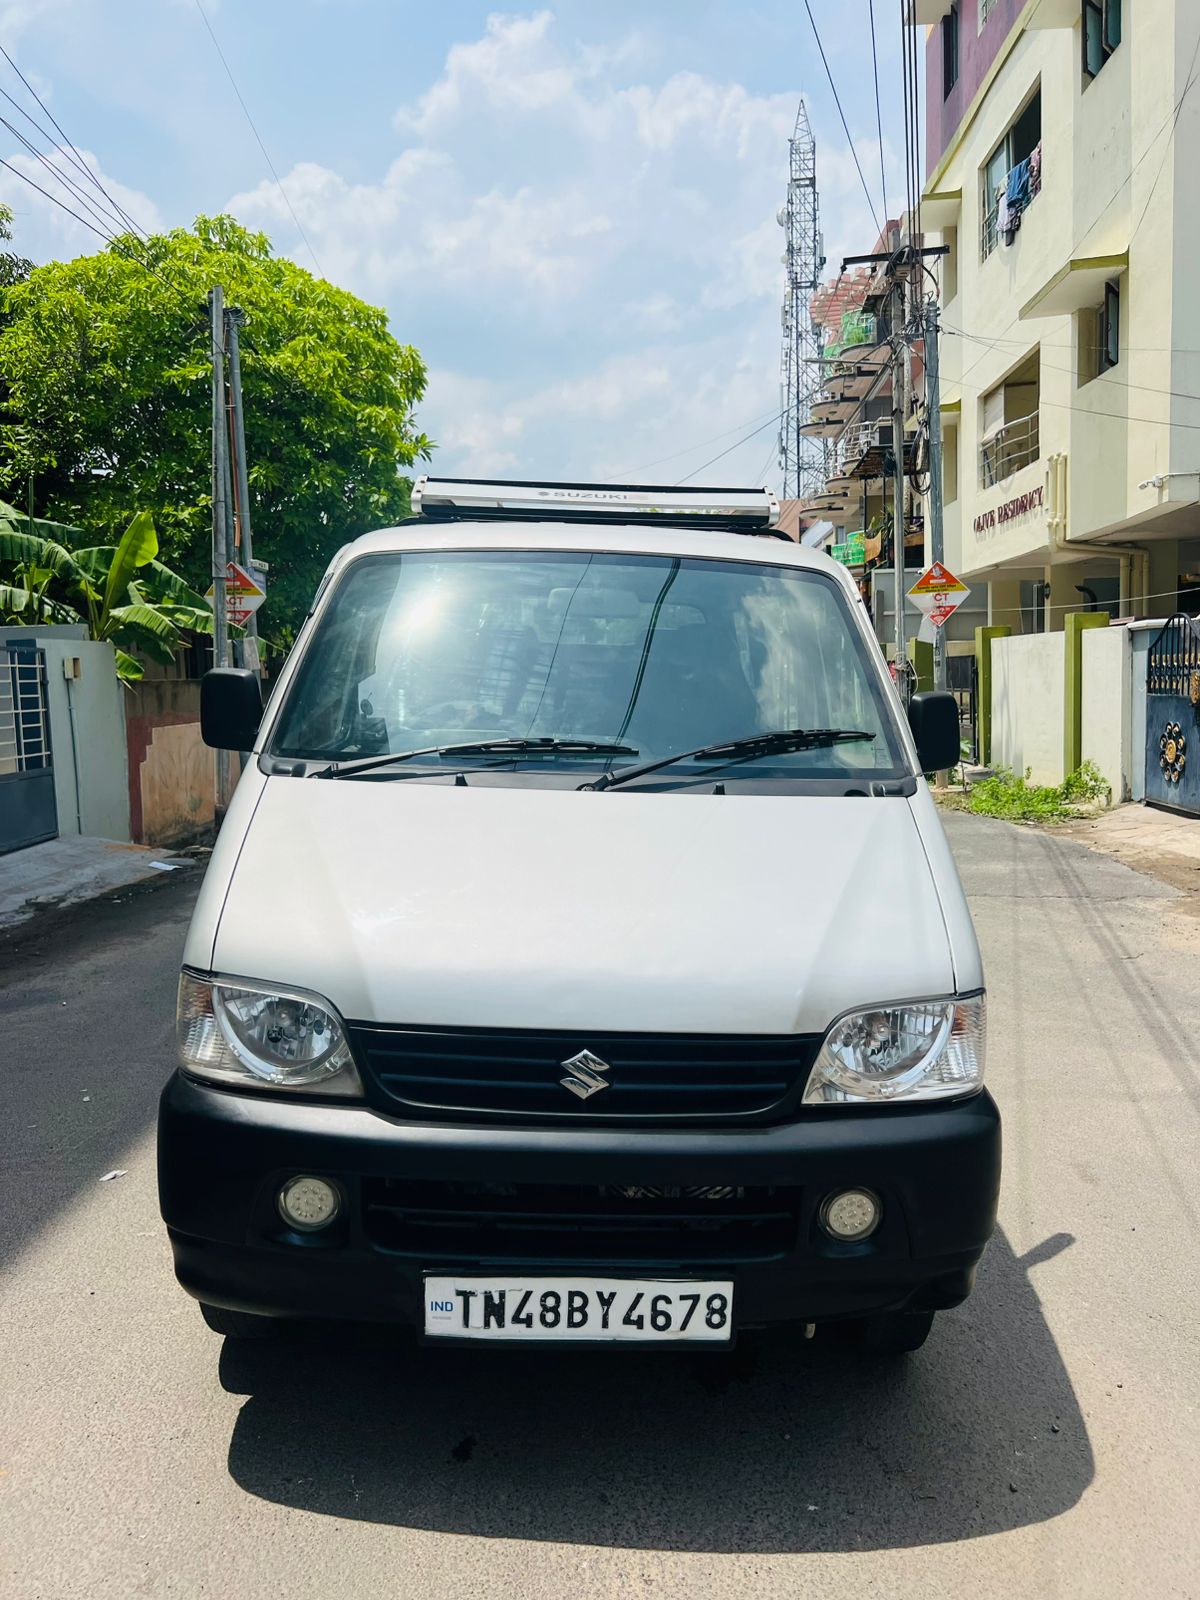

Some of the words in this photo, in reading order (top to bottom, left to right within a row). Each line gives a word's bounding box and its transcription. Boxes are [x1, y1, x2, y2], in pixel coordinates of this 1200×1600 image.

[554, 491, 627, 500] SUZUKI
[973, 509, 995, 532] OLIVE
[430, 1300, 454, 1313] IND
[455, 1288, 728, 1332] TN48BY4678
